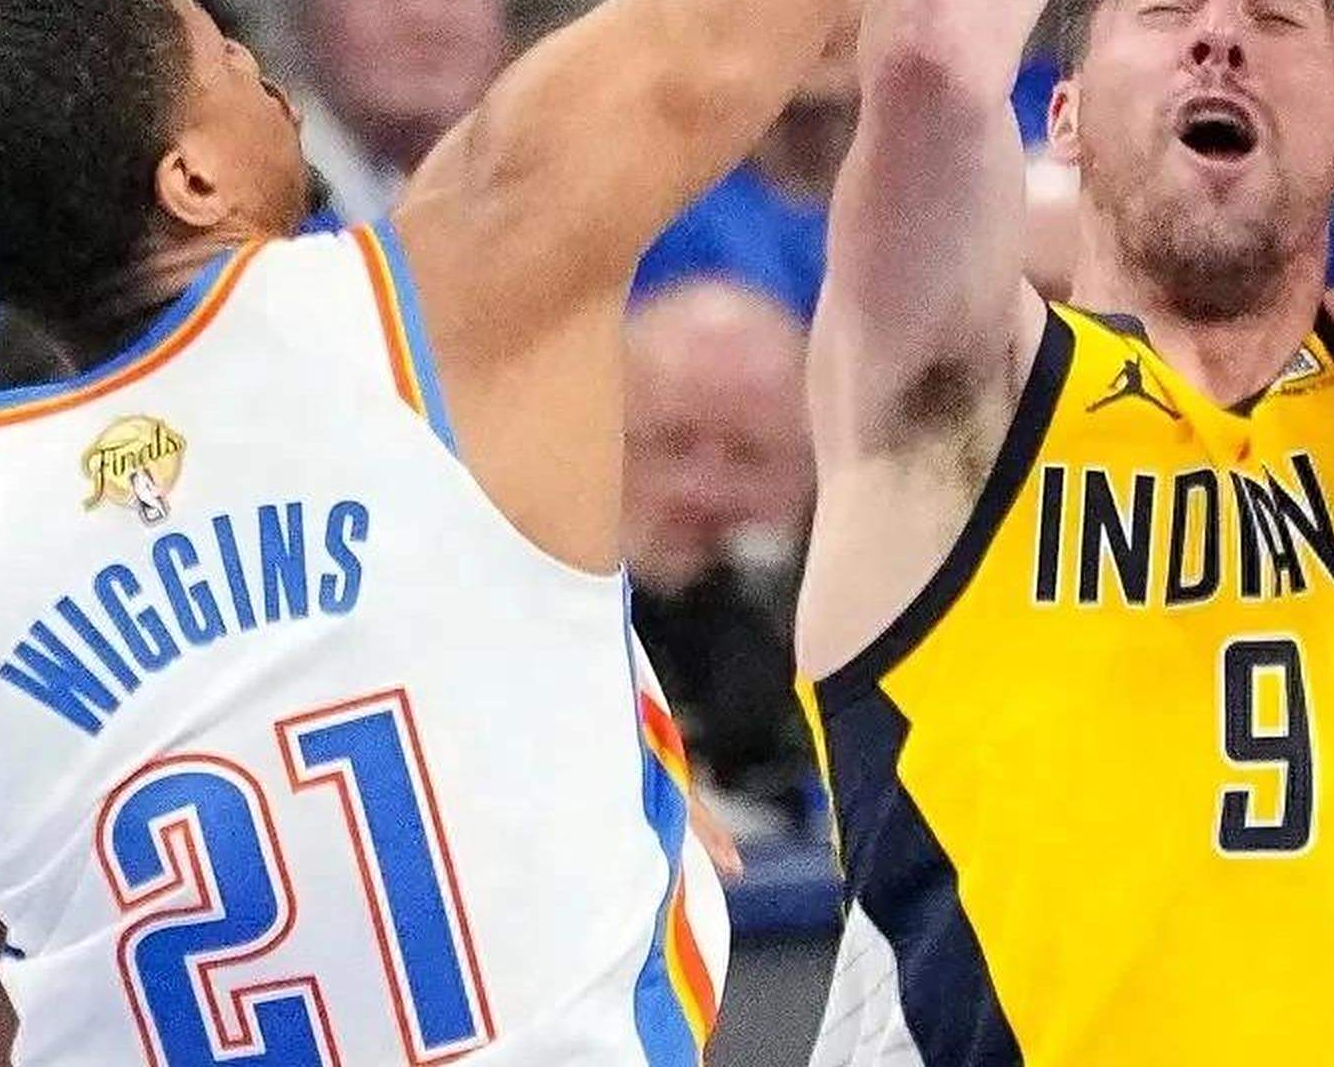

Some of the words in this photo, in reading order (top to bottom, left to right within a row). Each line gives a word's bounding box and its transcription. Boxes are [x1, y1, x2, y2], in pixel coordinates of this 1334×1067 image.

[82, 421, 186, 510] Finals
[1214, 631, 1319, 858] 9
[95, 686, 499, 1067] 21
